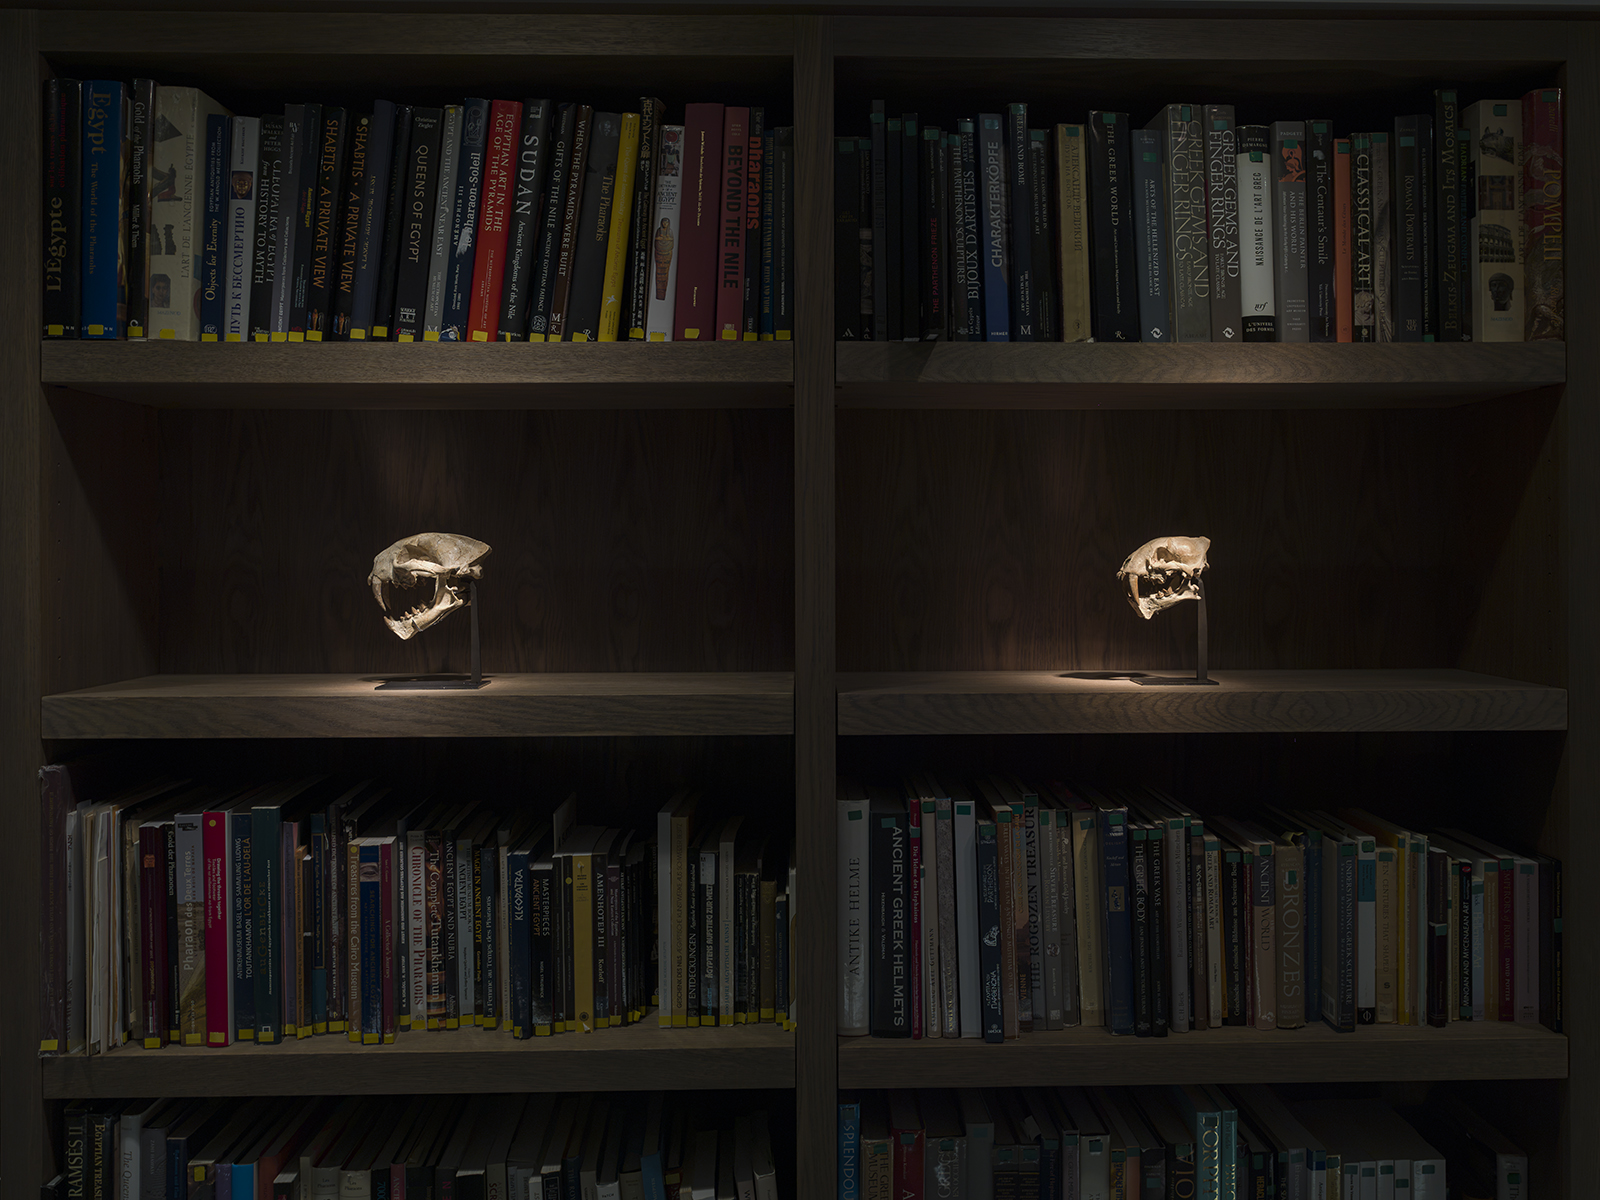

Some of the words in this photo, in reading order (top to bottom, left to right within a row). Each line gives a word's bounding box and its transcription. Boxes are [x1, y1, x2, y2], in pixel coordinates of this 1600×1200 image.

[88, 92, 111, 155] Egypt
[133, 102, 145, 124] Gold
[495, 112, 504, 133] AGE
[133, 134, 141, 144] the
[323, 120, 338, 172] SHABTIS
[493, 137, 502, 151] OF
[500, 113, 514, 167] EGYPTIAN
[575, 120, 586, 149] WHEN
[1106, 124, 1114, 144] THE
[133, 145, 144, 184] Pharaohs
[185, 135, 194, 170] ÉGYPTE
[262, 160, 270, 176] from
[352, 126, 367, 178] SHABTIS
[490, 155, 501, 175] THE
[553, 141, 565, 168] GIFTS
[573, 152, 582, 170] THE
[953, 147, 963, 166] THE
[1107, 148, 1117, 183] GREEK
[1208, 131, 1223, 194] FINGER
[1221, 130, 1235, 183] GREEK
[414, 145, 429, 197] QUEENS
[498, 170, 508, 190] ART
[515, 135, 539, 215] SUDAN
[552, 170, 562, 183] OF
[601, 175, 614, 194] The
[727, 145, 743, 212] BEYOND
[747, 136, 763, 229] pharaons
[1071, 144, 1080, 204] АЛЕКСАНДР
[1252, 173, 1261, 190] GREC
[1316, 162, 1327, 183] The
[90, 181, 98, 205] World
[182, 174, 192, 232] L'ANCIENNE
[259, 179, 269, 227] HISTORY
[320, 187, 331, 197] A
[350, 192, 360, 202] A
[484, 179, 498, 232] PYRAMIDS
[497, 193, 506, 205] IN
[549, 185, 560, 204] THE
[566, 172, 580, 220] PYRAMIDS
[953, 168, 964, 224] PARTHENON
[964, 171, 976, 246] D'ARTISTES
[986, 142, 1003, 267] CHARAKTERKÖPFE
[1109, 186, 1119, 226] WORLD
[1150, 200, 1157, 210] OF
[1253, 193, 1261, 212] L'ART
[1356, 154, 1369, 248] CLASSICAL
[1404, 175, 1415, 210] ROMAN
[90, 208, 97, 217] of
[412, 201, 423, 218] OF
[493, 210, 504, 232] THE
[547, 206, 558, 228] NILE
[596, 197, 610, 242] Pharaohs
[1210, 198, 1225, 249] RINGS
[1223, 187, 1238, 234] GEMS
[1253, 217, 1262, 225] DE
[1316, 186, 1328, 232] Centaur's
[1542, 169, 1562, 261] POMPEII
[89, 219, 97, 233] the
[182, 236, 191, 248] DE
[206, 218, 221, 252] Eternity
[257, 231, 266, 246] TO
[316, 201, 330, 252] PRIVATE
[343, 206, 359, 256] PRIVATE
[515, 220, 526, 247] Ancient
[562, 223, 575, 249] WERE
[725, 217, 740, 247] THE
[1073, 206, 1082, 251] ВЕЛИКИЙ
[1405, 214, 1416, 260] PORTRAITS
[44, 197, 67, 292] L'Égypte
[88, 236, 96, 274] Pharaohs
[232, 207, 245, 289] БЕССМЕРТИЮ
[408, 223, 421, 263] EGYPT
[544, 232, 553, 257] ANCIENT
[955, 227, 965, 284] SCULPTURES
[1151, 229, 1159, 275] HELLENIZED
[1226, 240, 1239, 278] AND
[1254, 229, 1264, 266] NAISSANCE
[1317, 236, 1329, 265] Smile
[181, 255, 190, 278] L'ART
[206, 254, 217, 266] for
[255, 251, 265, 284] MYTH
[313, 256, 327, 289] VIEW
[511, 248, 523, 282] Kingdoms
[540, 259, 550, 286] EGYPTIAN
[558, 252, 571, 276] BUILT
[723, 252, 739, 289] NILE
[967, 250, 979, 299] BIJOUX
[1358, 250, 1371, 285] ART
[204, 268, 216, 301] Objects
[340, 261, 354, 293] VIEW
[1152, 278, 1160, 296] EAST
[232, 292, 240, 300] К
[507, 305, 517, 320] Nile
[510, 292, 519, 303] the
[537, 288, 547, 311] FAIENCE
[230, 304, 240, 333] ПУТЬ
[167, 830, 175, 846] Gold
[167, 849, 175, 860] der
[1025, 809, 1036, 878] TREASUR
[349, 854, 359, 895] Treasures
[411, 846, 424, 906] CHRONICLE
[429, 850, 439, 869] The
[446, 840, 454, 879] ANCIENT
[892, 826, 903, 894] ANCIENT
[1153, 859, 1161, 886] GREEK
[168, 861, 176, 896] Pharaonen
[427, 872, 439, 918] Complete
[445, 882, 455, 908] EGYPT
[514, 869, 524, 921] KLEOPATRA
[849, 858, 859, 910] HELME
[350, 897, 359, 920] from
[541, 879, 550, 936] MASTERPIECES
[596, 873, 605, 934] AMENHOTEP
[1154, 887, 1162, 906] VASE
[350, 921, 359, 934] the
[412, 910, 423, 922] OF
[446, 911, 455, 930] AND
[532, 913, 540, 936] EGYPT
[893, 898, 903, 950] GREEK
[1028, 884, 1038, 957] ROGOZEN
[350, 936, 359, 960] Cairo
[412, 926, 423, 947] THE
[447, 933, 455, 960] NUBIA
[597, 936, 605, 947] III
[849, 919, 860, 976] ANTIKE
[1282, 880, 1300, 997] BRONZES
[1503, 925, 1511, 950] ROME
[429, 919, 442, 1000] Tutankhamun
[597, 959, 605, 983] Kozloff
[688, 933, 697, 999] ENTDECKUNGEN
[350, 962, 359, 999] Museum
[413, 949, 425, 1005] PHARAOHS
[893, 954, 904, 1026] HELMETS
[1030, 962, 1041, 992] THE
[1345, 959, 1353, 1004] SCULPTURE
[69, 1126, 83, 1138] II
[95, 1123, 105, 1166] EGYPTIAN
[66, 1140, 83, 1198] RAMSÈS
